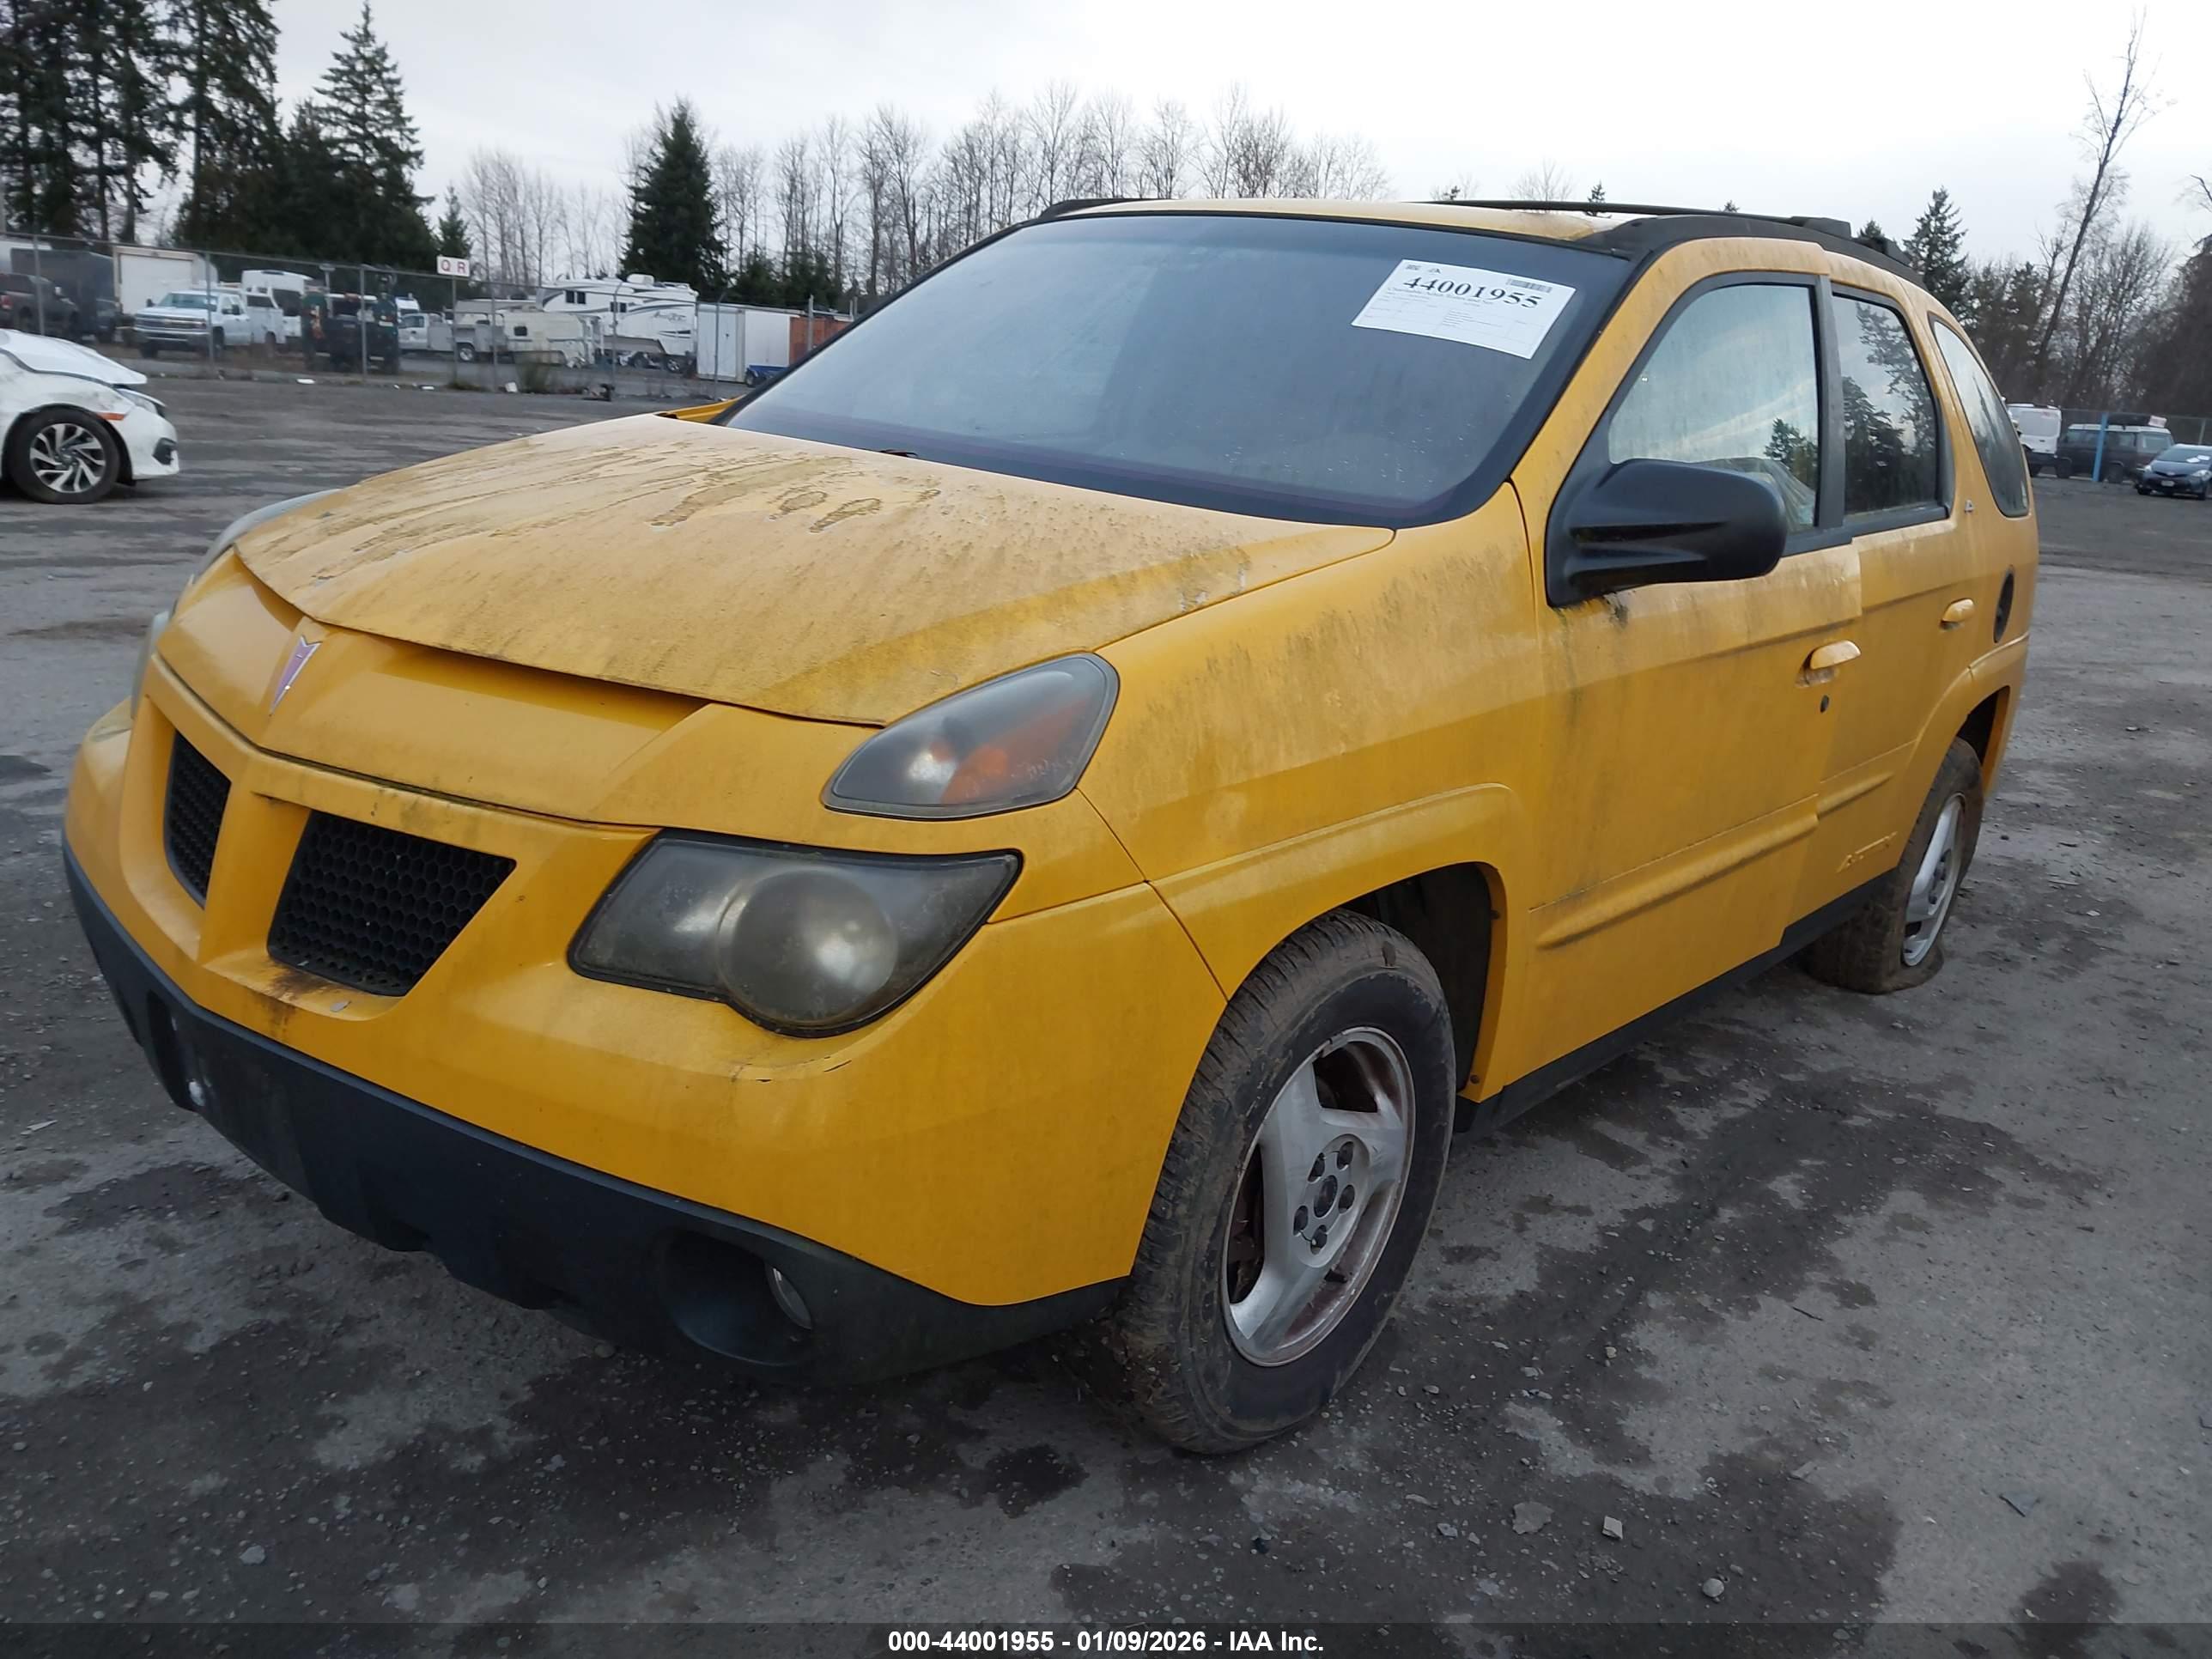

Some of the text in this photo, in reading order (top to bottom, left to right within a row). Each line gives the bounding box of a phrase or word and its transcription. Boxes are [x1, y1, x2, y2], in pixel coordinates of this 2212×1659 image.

[441, 259, 466, 274] Q R
[1403, 276, 1542, 308] 44001955
